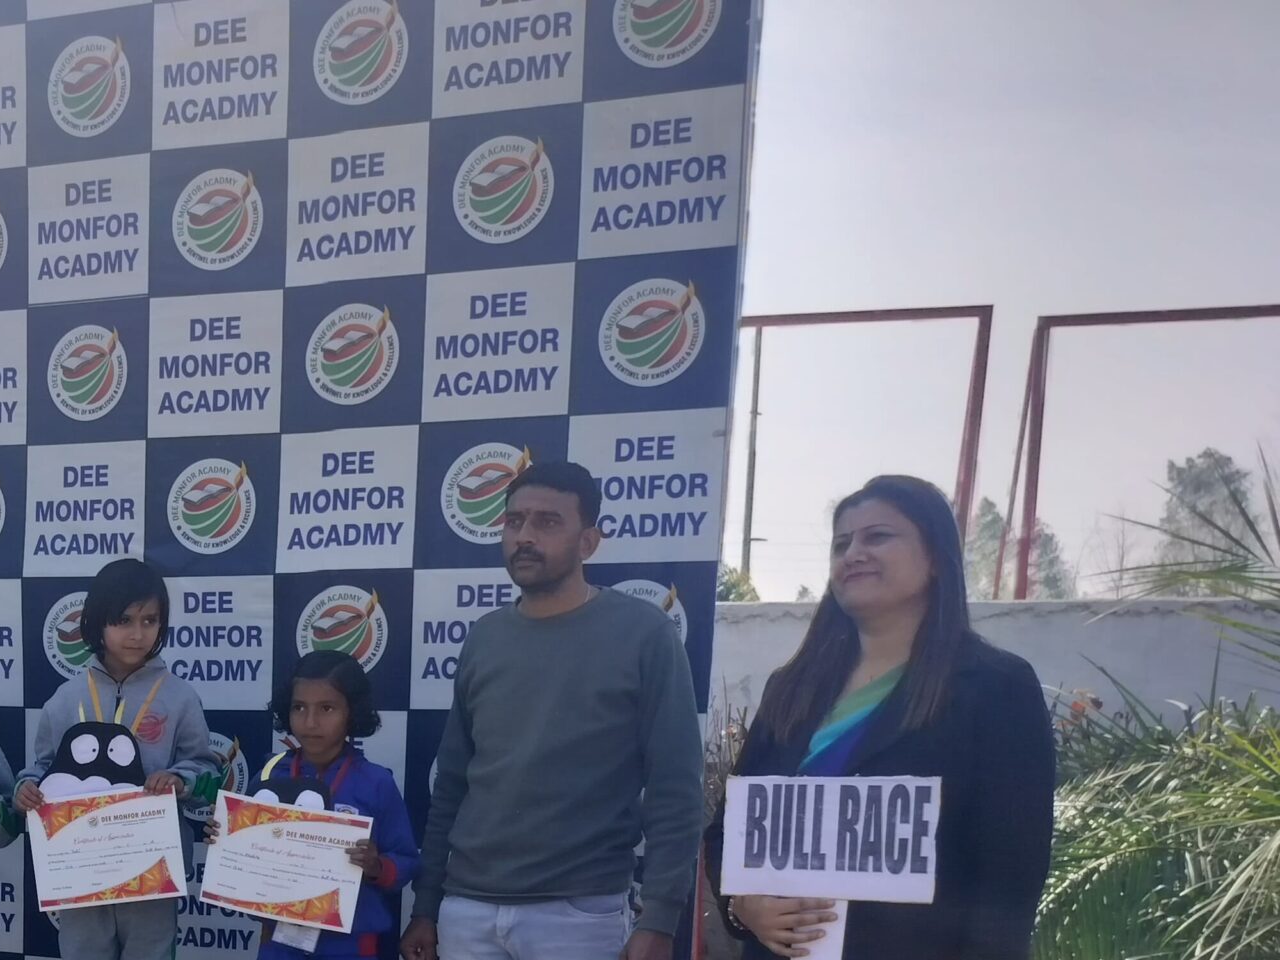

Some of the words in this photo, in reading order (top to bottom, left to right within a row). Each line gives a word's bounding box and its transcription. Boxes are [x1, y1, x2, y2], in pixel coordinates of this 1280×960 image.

[194, 17, 247, 47] DEE
[445, 11, 572, 52] MONFOR
[164, 53, 277, 88] MONFOR
[444, 51, 572, 92] ACADMY
[162, 91, 278, 126] ACADMY
[630, 117, 692, 149] DEE
[331, 152, 385, 183] DEE
[593, 154, 727, 192] MONFOR
[65, 178, 112, 207] DEE
[298, 187, 415, 225] MONFOR
[591, 194, 727, 232] ACADMY
[38, 212, 139, 245] MONFOR
[297, 225, 416, 262] ACADMY
[37, 248, 139, 280] ACADMY
[470, 291, 527, 319] DEE
[190, 316, 241, 342] DEE
[435, 328, 559, 360] MONFOR
[159, 351, 270, 379] MONFOR
[433, 366, 559, 397] ACADMY
[158, 387, 271, 415] ACADMY
[615, 435, 675, 462] DEE
[63, 464, 109, 488] DEE
[322, 451, 375, 477] DEE
[35, 498, 134, 522] MONFOR
[289, 486, 404, 515] MONFOR
[287, 522, 404, 550] ACADMY
[597, 512, 708, 539] CADMY
[33, 532, 135, 556] ACADMY
[184, 591, 233, 614] DEE
[456, 584, 513, 608] DEE
[170, 659, 263, 681] CADMY
[744, 783, 827, 872] BULL
[835, 783, 932, 875] RACE
